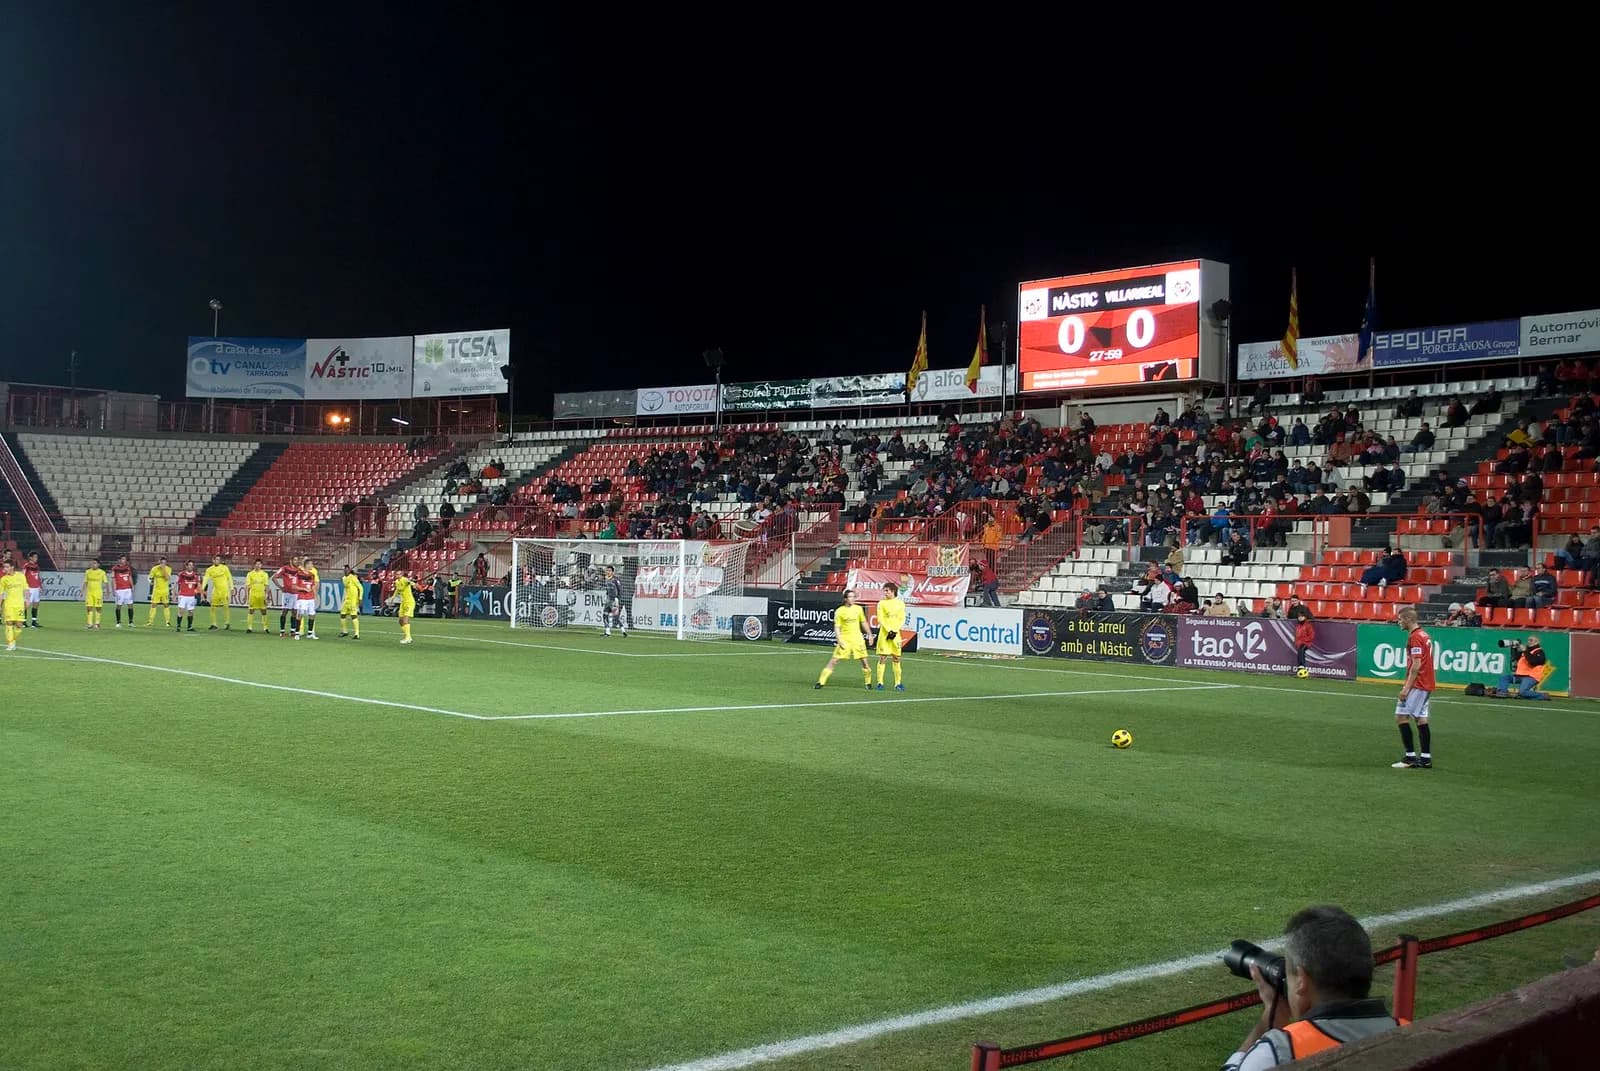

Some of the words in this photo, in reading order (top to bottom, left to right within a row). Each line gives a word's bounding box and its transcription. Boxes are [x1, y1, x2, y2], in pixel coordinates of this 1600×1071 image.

[1053, 292, 1098, 311] NÀSTIC
[1105, 285, 1164, 303] VILLARREAL
[1058, 316, 1084, 353] 0
[1126, 309, 1155, 348] 0
[1529, 316, 1600, 334] Automóvi
[447, 335, 497, 358] TCSA
[1422, 340, 1491, 354] PORCELANOSA
[1529, 334, 1581, 346] Bermar
[1246, 361, 1257, 372] LA
[1259, 358, 1310, 371] HACIEDA
[934, 372, 966, 387] alfo
[667, 389, 718, 402] TOYOTA
[777, 606, 835, 624] CatalunyaC
[916, 617, 951, 640] Parc
[955, 619, 1019, 645] Central
[1068, 621, 1075, 631] a
[1079, 620, 1095, 633] tot
[1098, 621, 1125, 634] arreu
[1060, 640, 1083, 653] amb
[1086, 640, 1096, 654] el
[1100, 641, 1133, 657] Nàstic
[1193, 659, 1227, 668] TELEVISIÓ
[1227, 661, 1256, 670] PÚBLICA
[1272, 664, 1291, 672] CAMP
